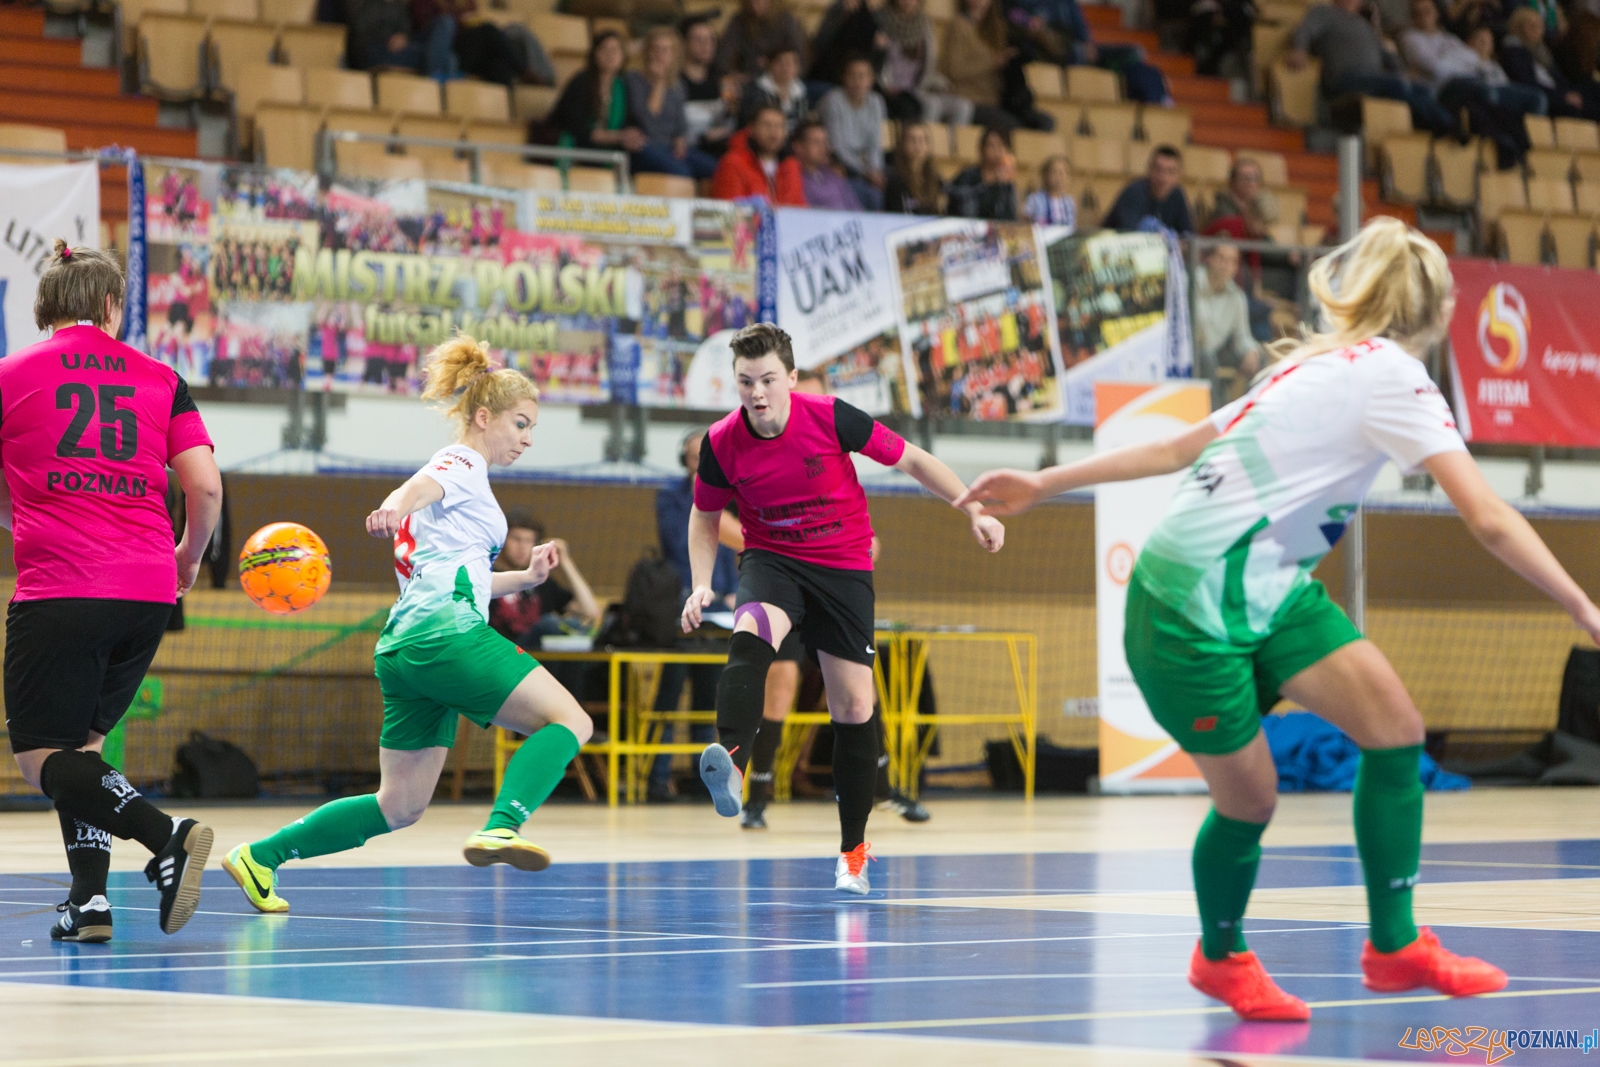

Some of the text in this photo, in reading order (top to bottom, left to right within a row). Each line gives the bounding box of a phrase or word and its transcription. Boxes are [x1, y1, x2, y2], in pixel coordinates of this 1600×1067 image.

[292, 248, 627, 317] MISTRZ POLSKI
[790, 250, 874, 314] UAM
[60, 353, 127, 373] UAM
[55, 382, 138, 461] 25
[47, 471, 148, 497] POZNAŃ
[76, 827, 112, 846] UAM
